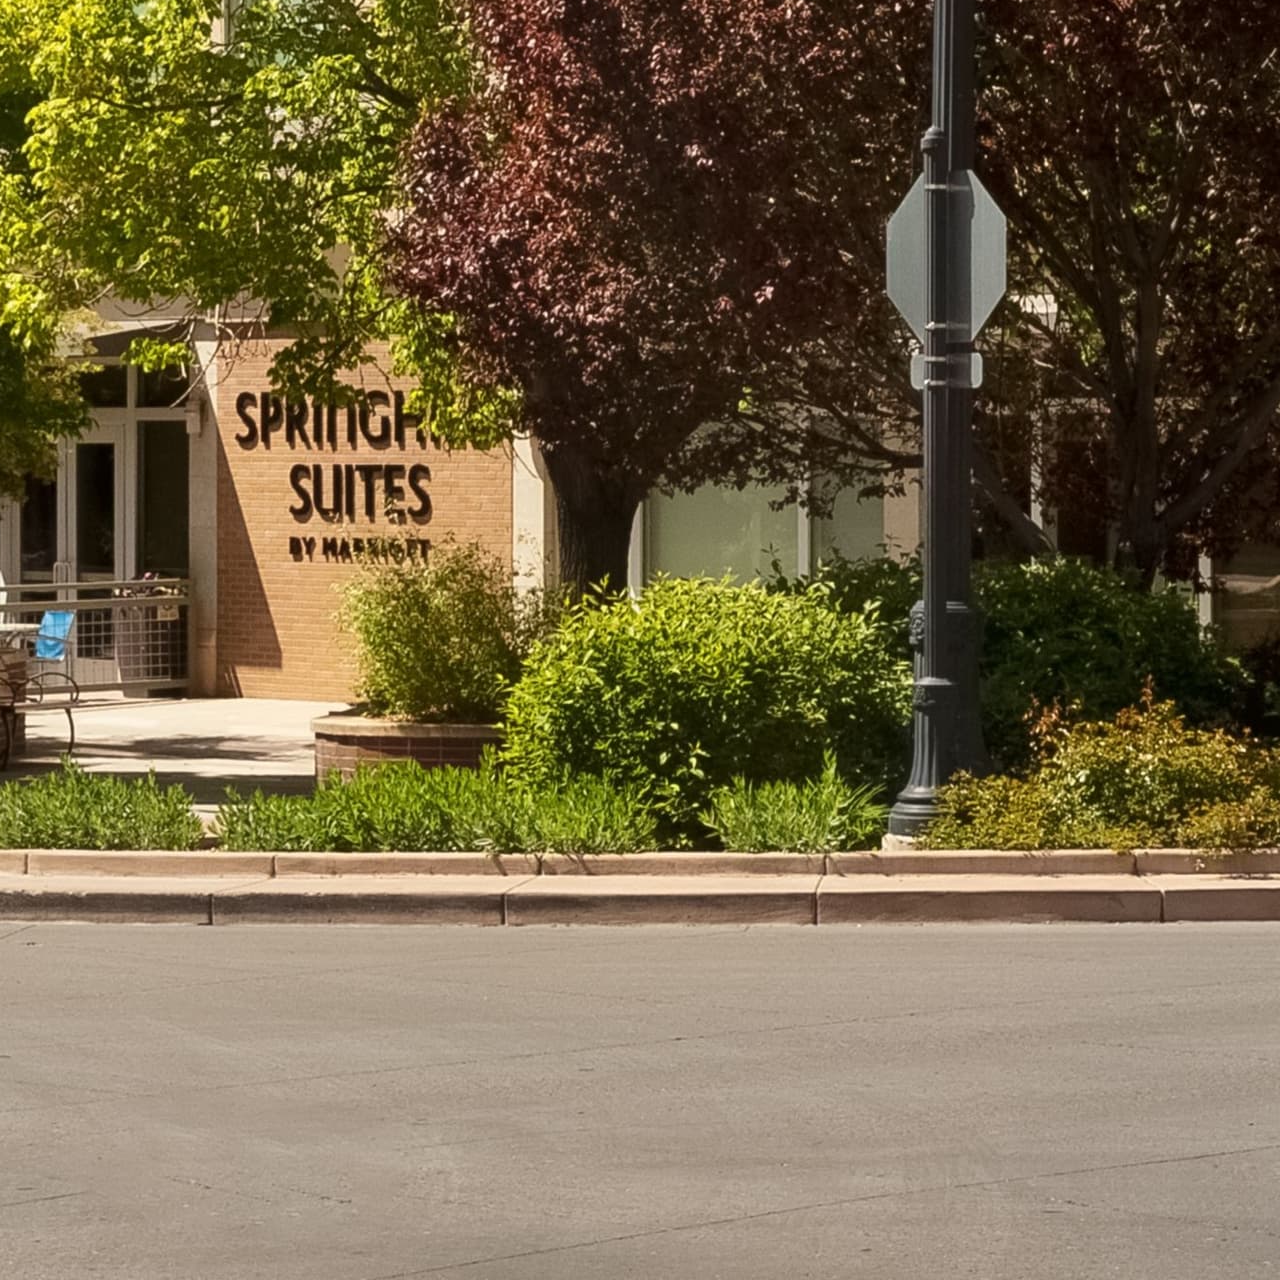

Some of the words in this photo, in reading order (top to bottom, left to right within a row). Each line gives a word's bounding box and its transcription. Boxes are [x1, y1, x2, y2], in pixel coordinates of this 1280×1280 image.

[235, 390, 495, 446] SPRINGH
[289, 463, 432, 521] SUITES
[289, 536, 316, 559] BY
